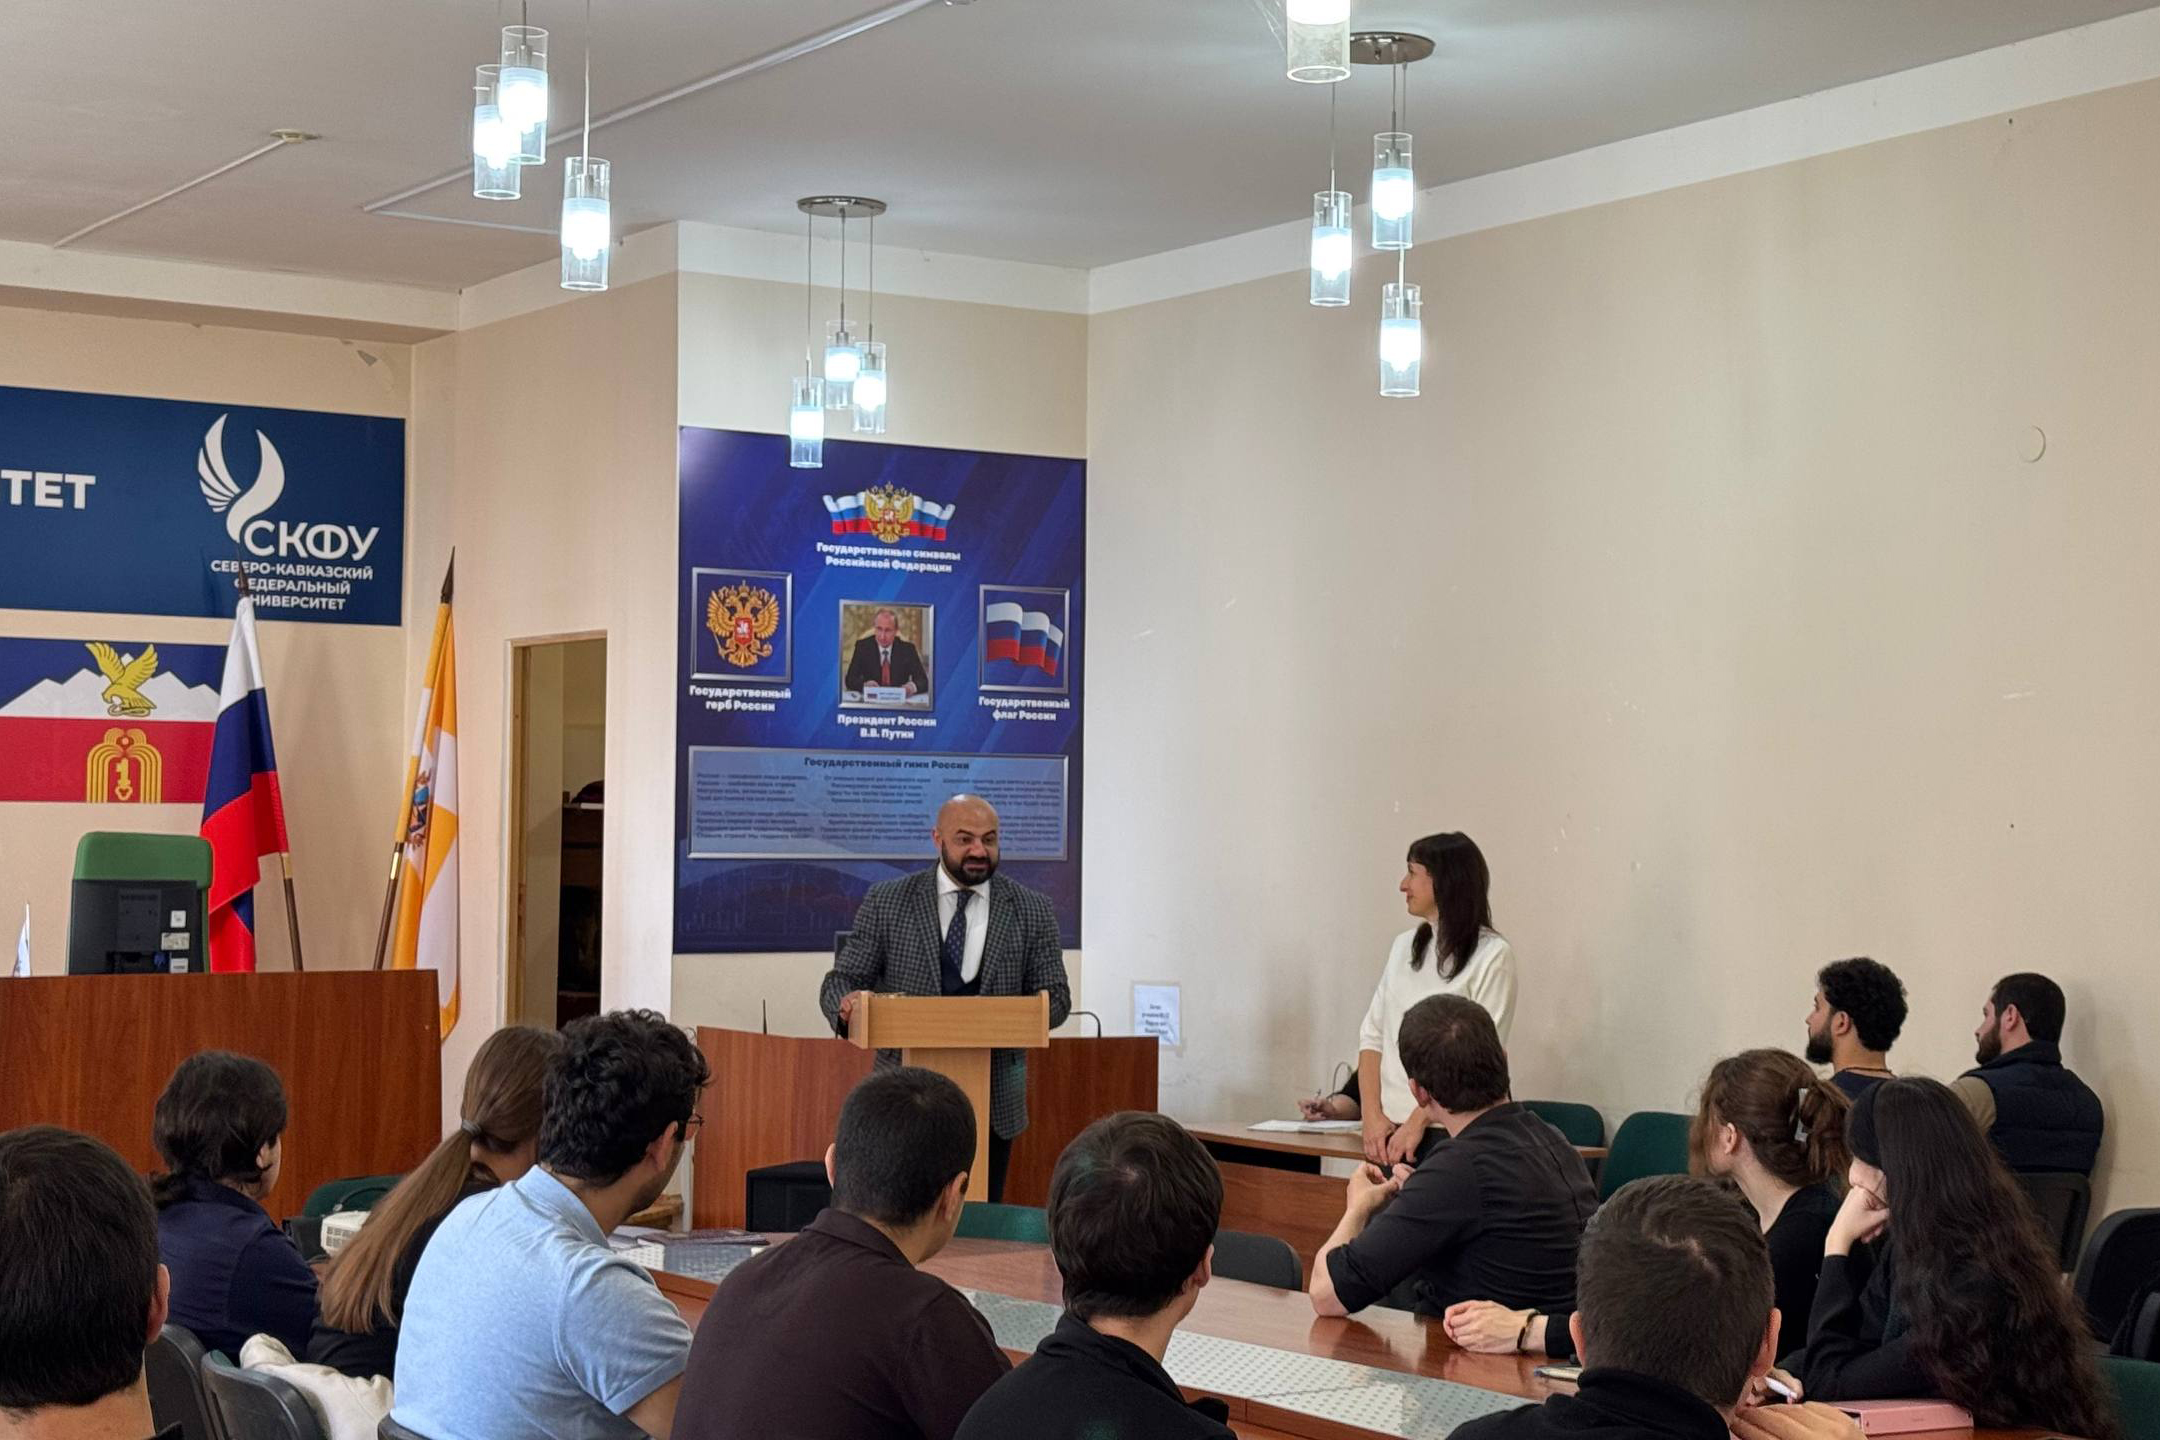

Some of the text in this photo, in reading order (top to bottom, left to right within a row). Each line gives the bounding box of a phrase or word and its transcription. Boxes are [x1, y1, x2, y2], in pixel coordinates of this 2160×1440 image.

[1, 469, 96, 510] ТЕТ
[244, 520, 380, 561] СКФУ
[816, 542, 961, 561] Государственные символы
[211, 560, 373, 580] СЕВЕРО-КАВКАЗСКИЙ
[825, 555, 952, 573] Российской Федерации
[250, 594, 346, 610] НИВЕРСИТЕТ
[689, 685, 791, 699] Государственный
[706, 699, 775, 712] герб России
[978, 696, 1070, 709] Государственный
[837, 714, 937, 727] Президент России
[992, 709, 1056, 721] флаг России
[860, 727, 914, 740] В.В. Путин
[804, 757, 969, 770] Государственный гимн России
